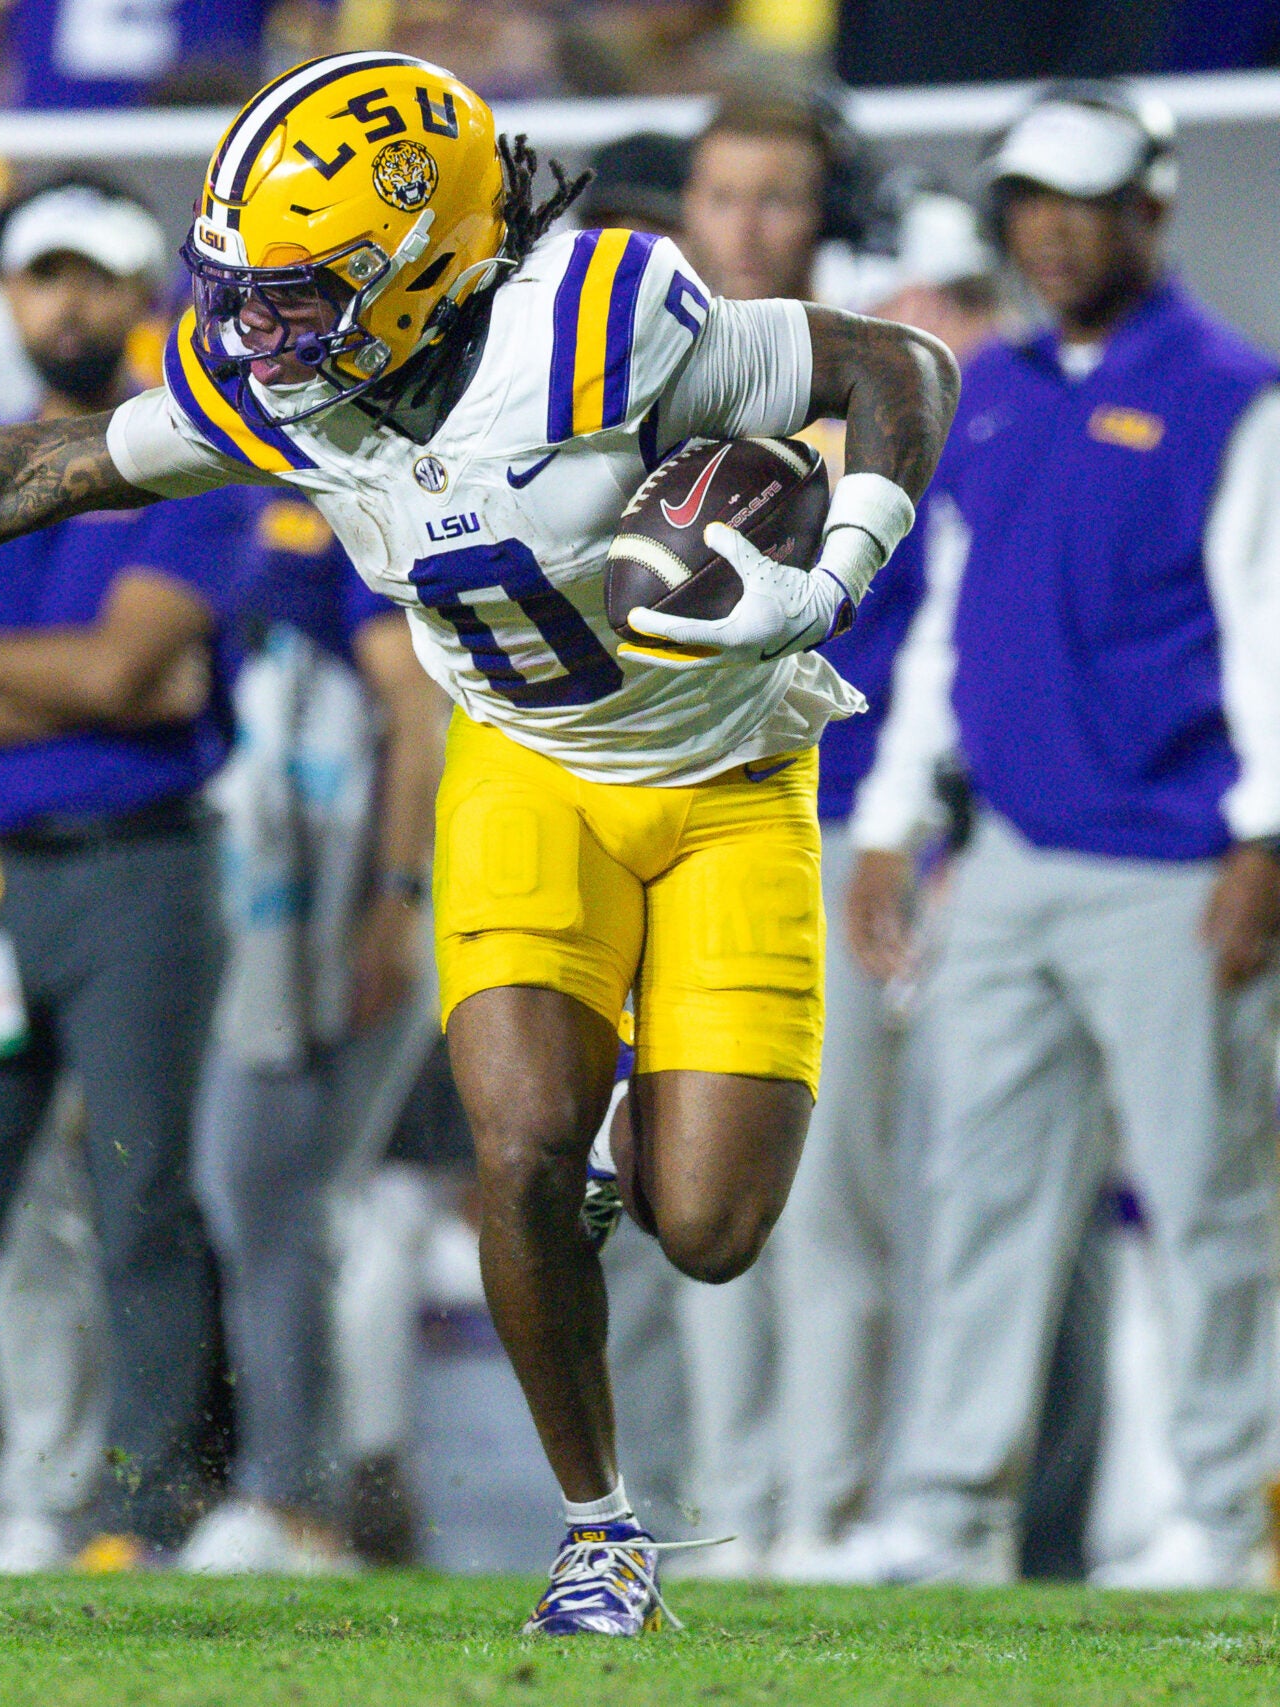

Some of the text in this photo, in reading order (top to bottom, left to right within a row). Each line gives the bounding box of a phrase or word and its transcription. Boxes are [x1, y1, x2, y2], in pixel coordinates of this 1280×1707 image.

[293, 86, 459, 181] LSU
[199, 224, 227, 253] LSU
[425, 512, 481, 542] LSU
[408, 537, 625, 709] 0
[573, 1531, 607, 1542] LSU
